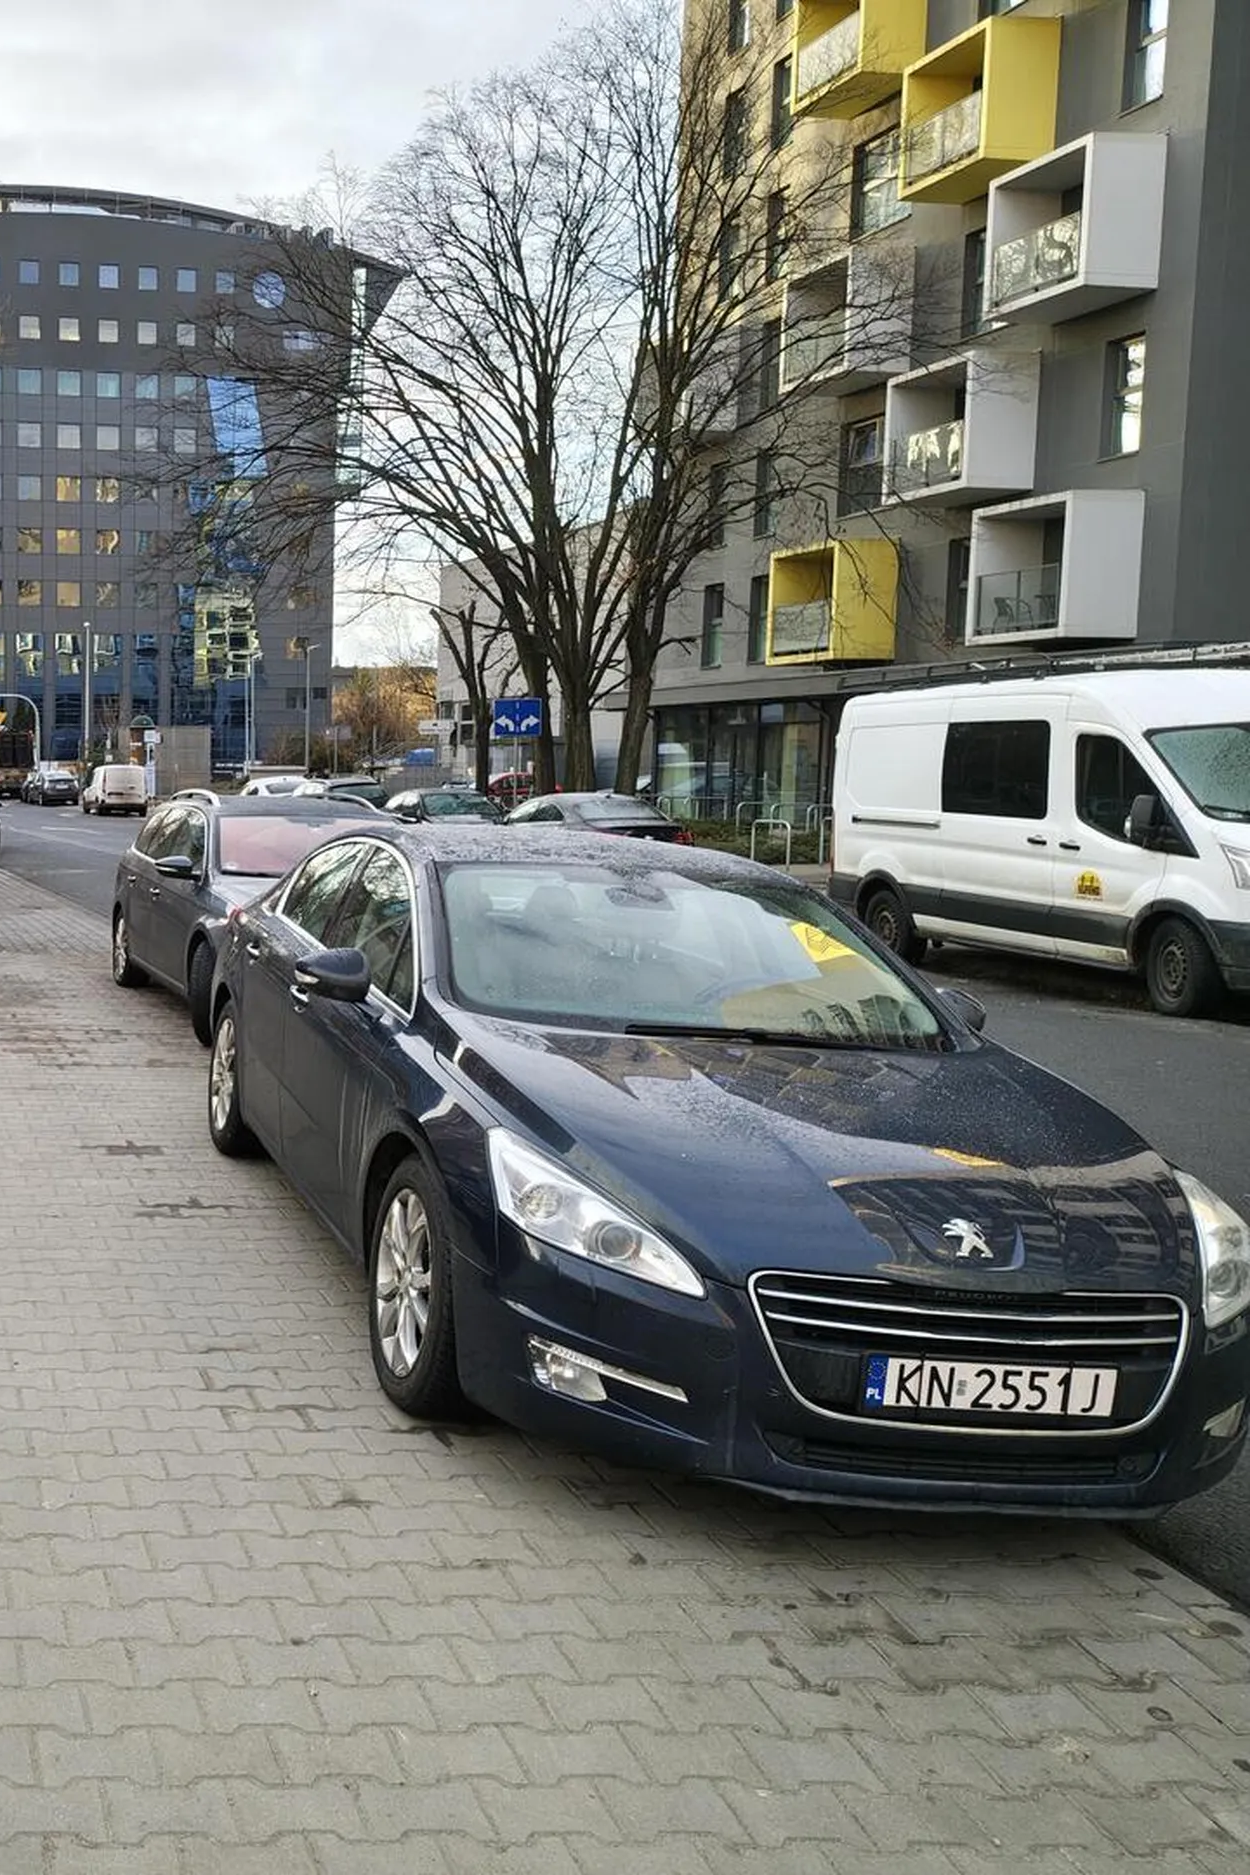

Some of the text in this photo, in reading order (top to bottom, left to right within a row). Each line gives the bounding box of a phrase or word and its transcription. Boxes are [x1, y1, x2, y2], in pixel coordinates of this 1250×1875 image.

[866, 1387, 882, 1400] PL
[895, 1363, 1100, 1414] KN 2551J
